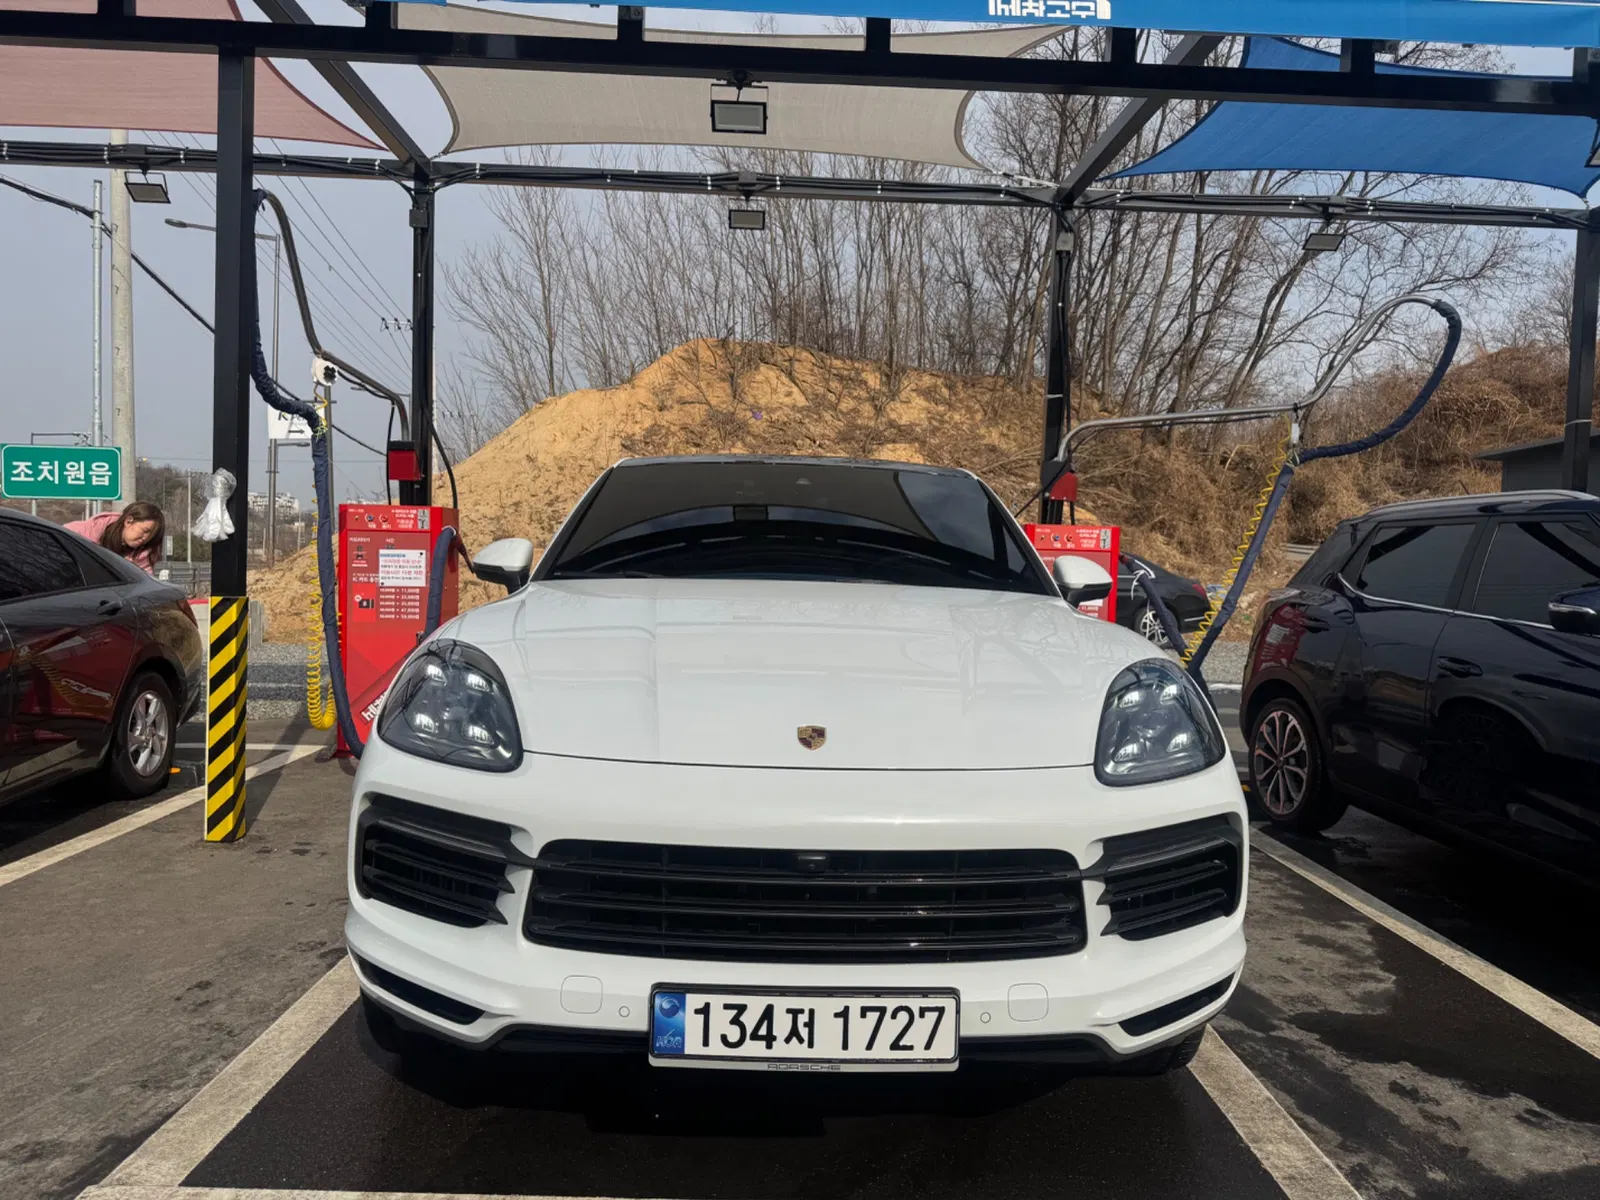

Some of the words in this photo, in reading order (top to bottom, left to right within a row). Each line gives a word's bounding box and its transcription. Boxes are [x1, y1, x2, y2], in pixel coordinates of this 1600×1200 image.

[10, 460, 113, 486] 조치원읍
[693, 1001, 816, 1050] 134저
[833, 1004, 946, 1051] 1727
[767, 1063, 841, 1071] PORSCHE
